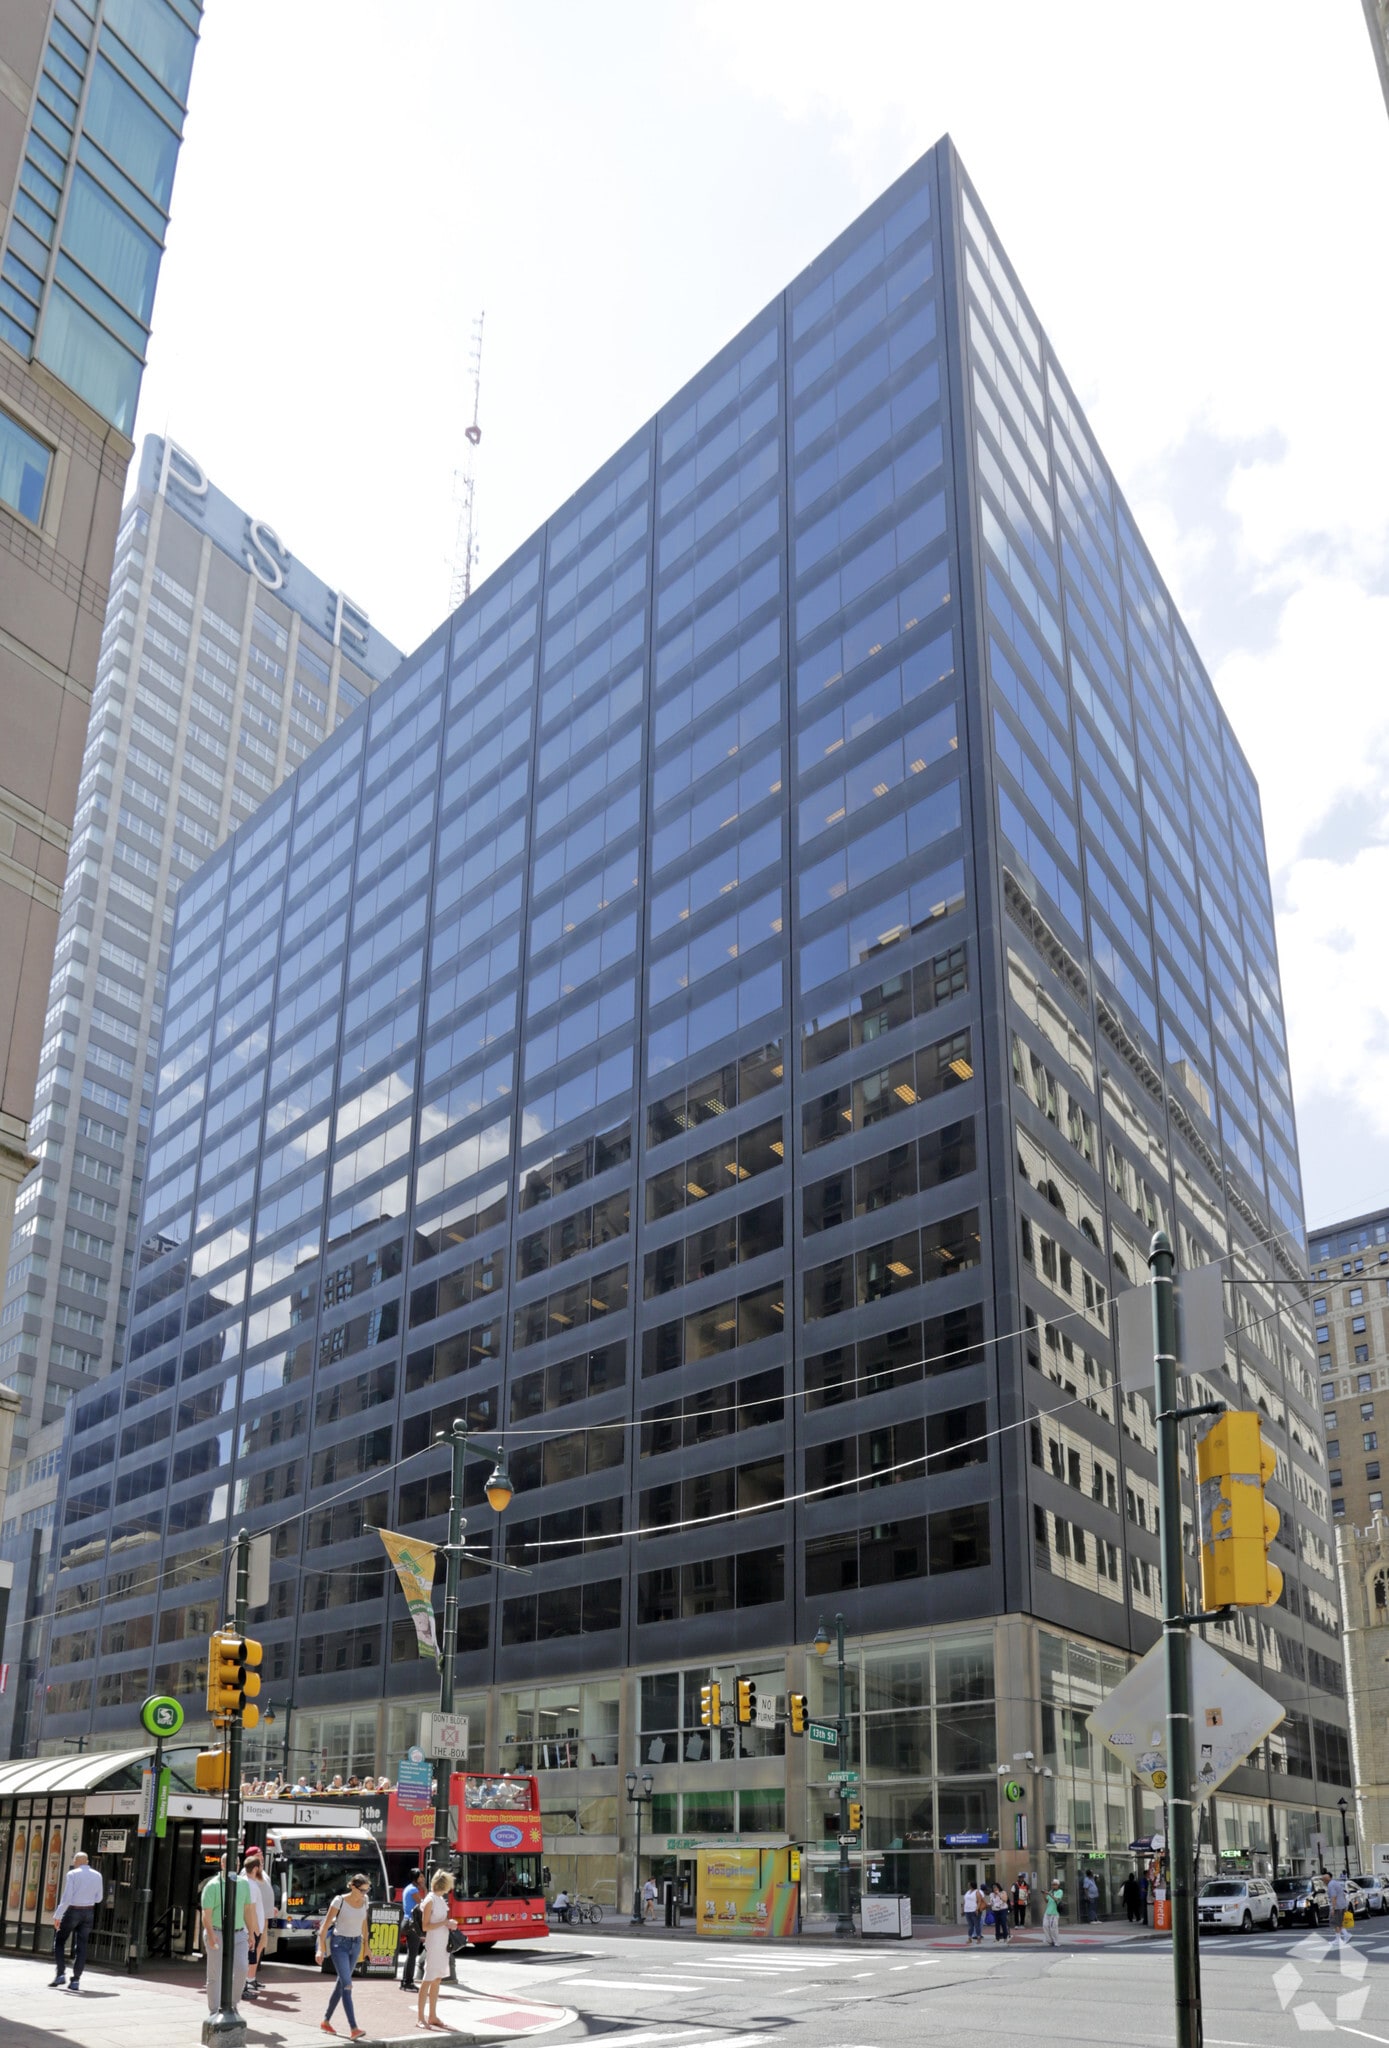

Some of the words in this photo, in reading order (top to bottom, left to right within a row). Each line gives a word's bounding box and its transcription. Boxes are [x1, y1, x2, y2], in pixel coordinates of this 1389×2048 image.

[761, 1699, 772, 1710] NO
[450, 1716, 467, 1725] BLOCK
[758, 1712, 775, 1723] TURNS
[812, 1728, 826, 1739] 13th
[826, 1730, 834, 1740] St
[433, 1746, 448, 1756] THE
[450, 1748, 466, 1758] BOX
[246, 1806, 274, 1814] Honest
[366, 1806, 381, 1818] the
[369, 1923, 398, 1950] 300
